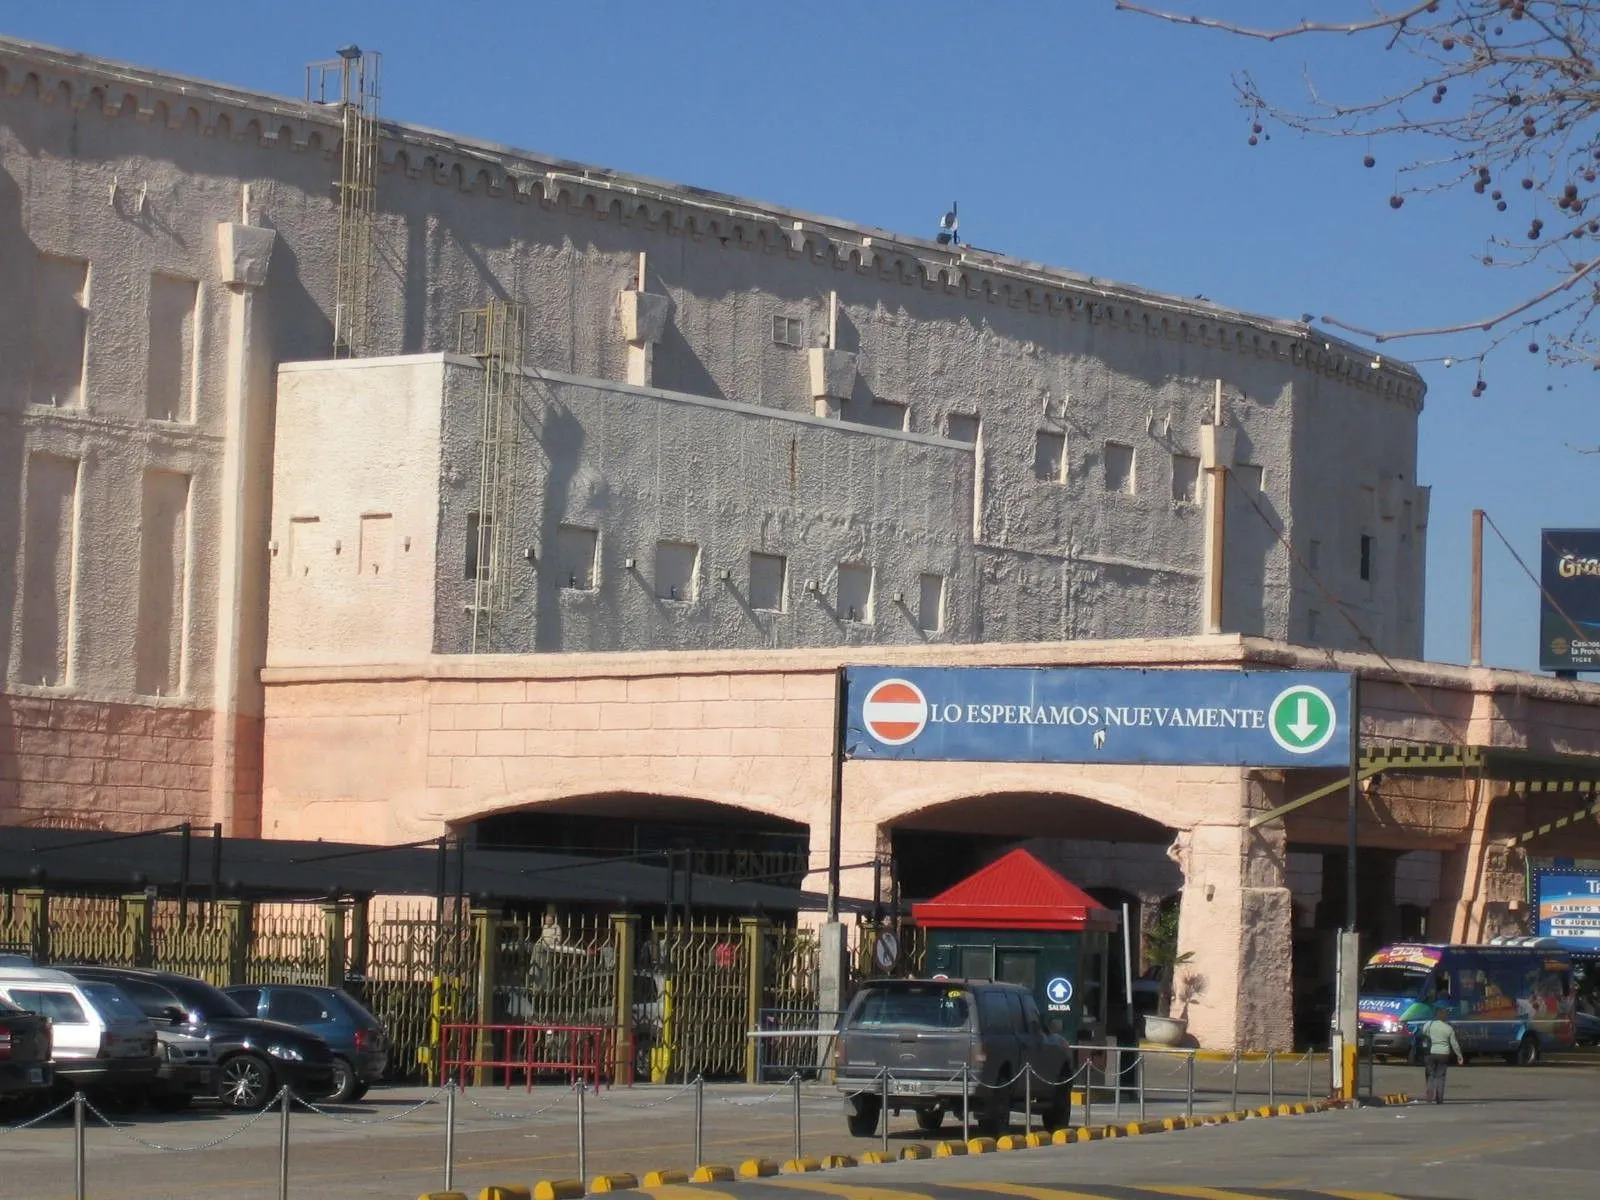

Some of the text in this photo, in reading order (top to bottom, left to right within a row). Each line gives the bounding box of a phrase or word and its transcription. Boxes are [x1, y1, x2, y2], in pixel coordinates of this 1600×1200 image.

[930, 704, 1265, 729] LO ESPERAMOS NUEVAMENTE
